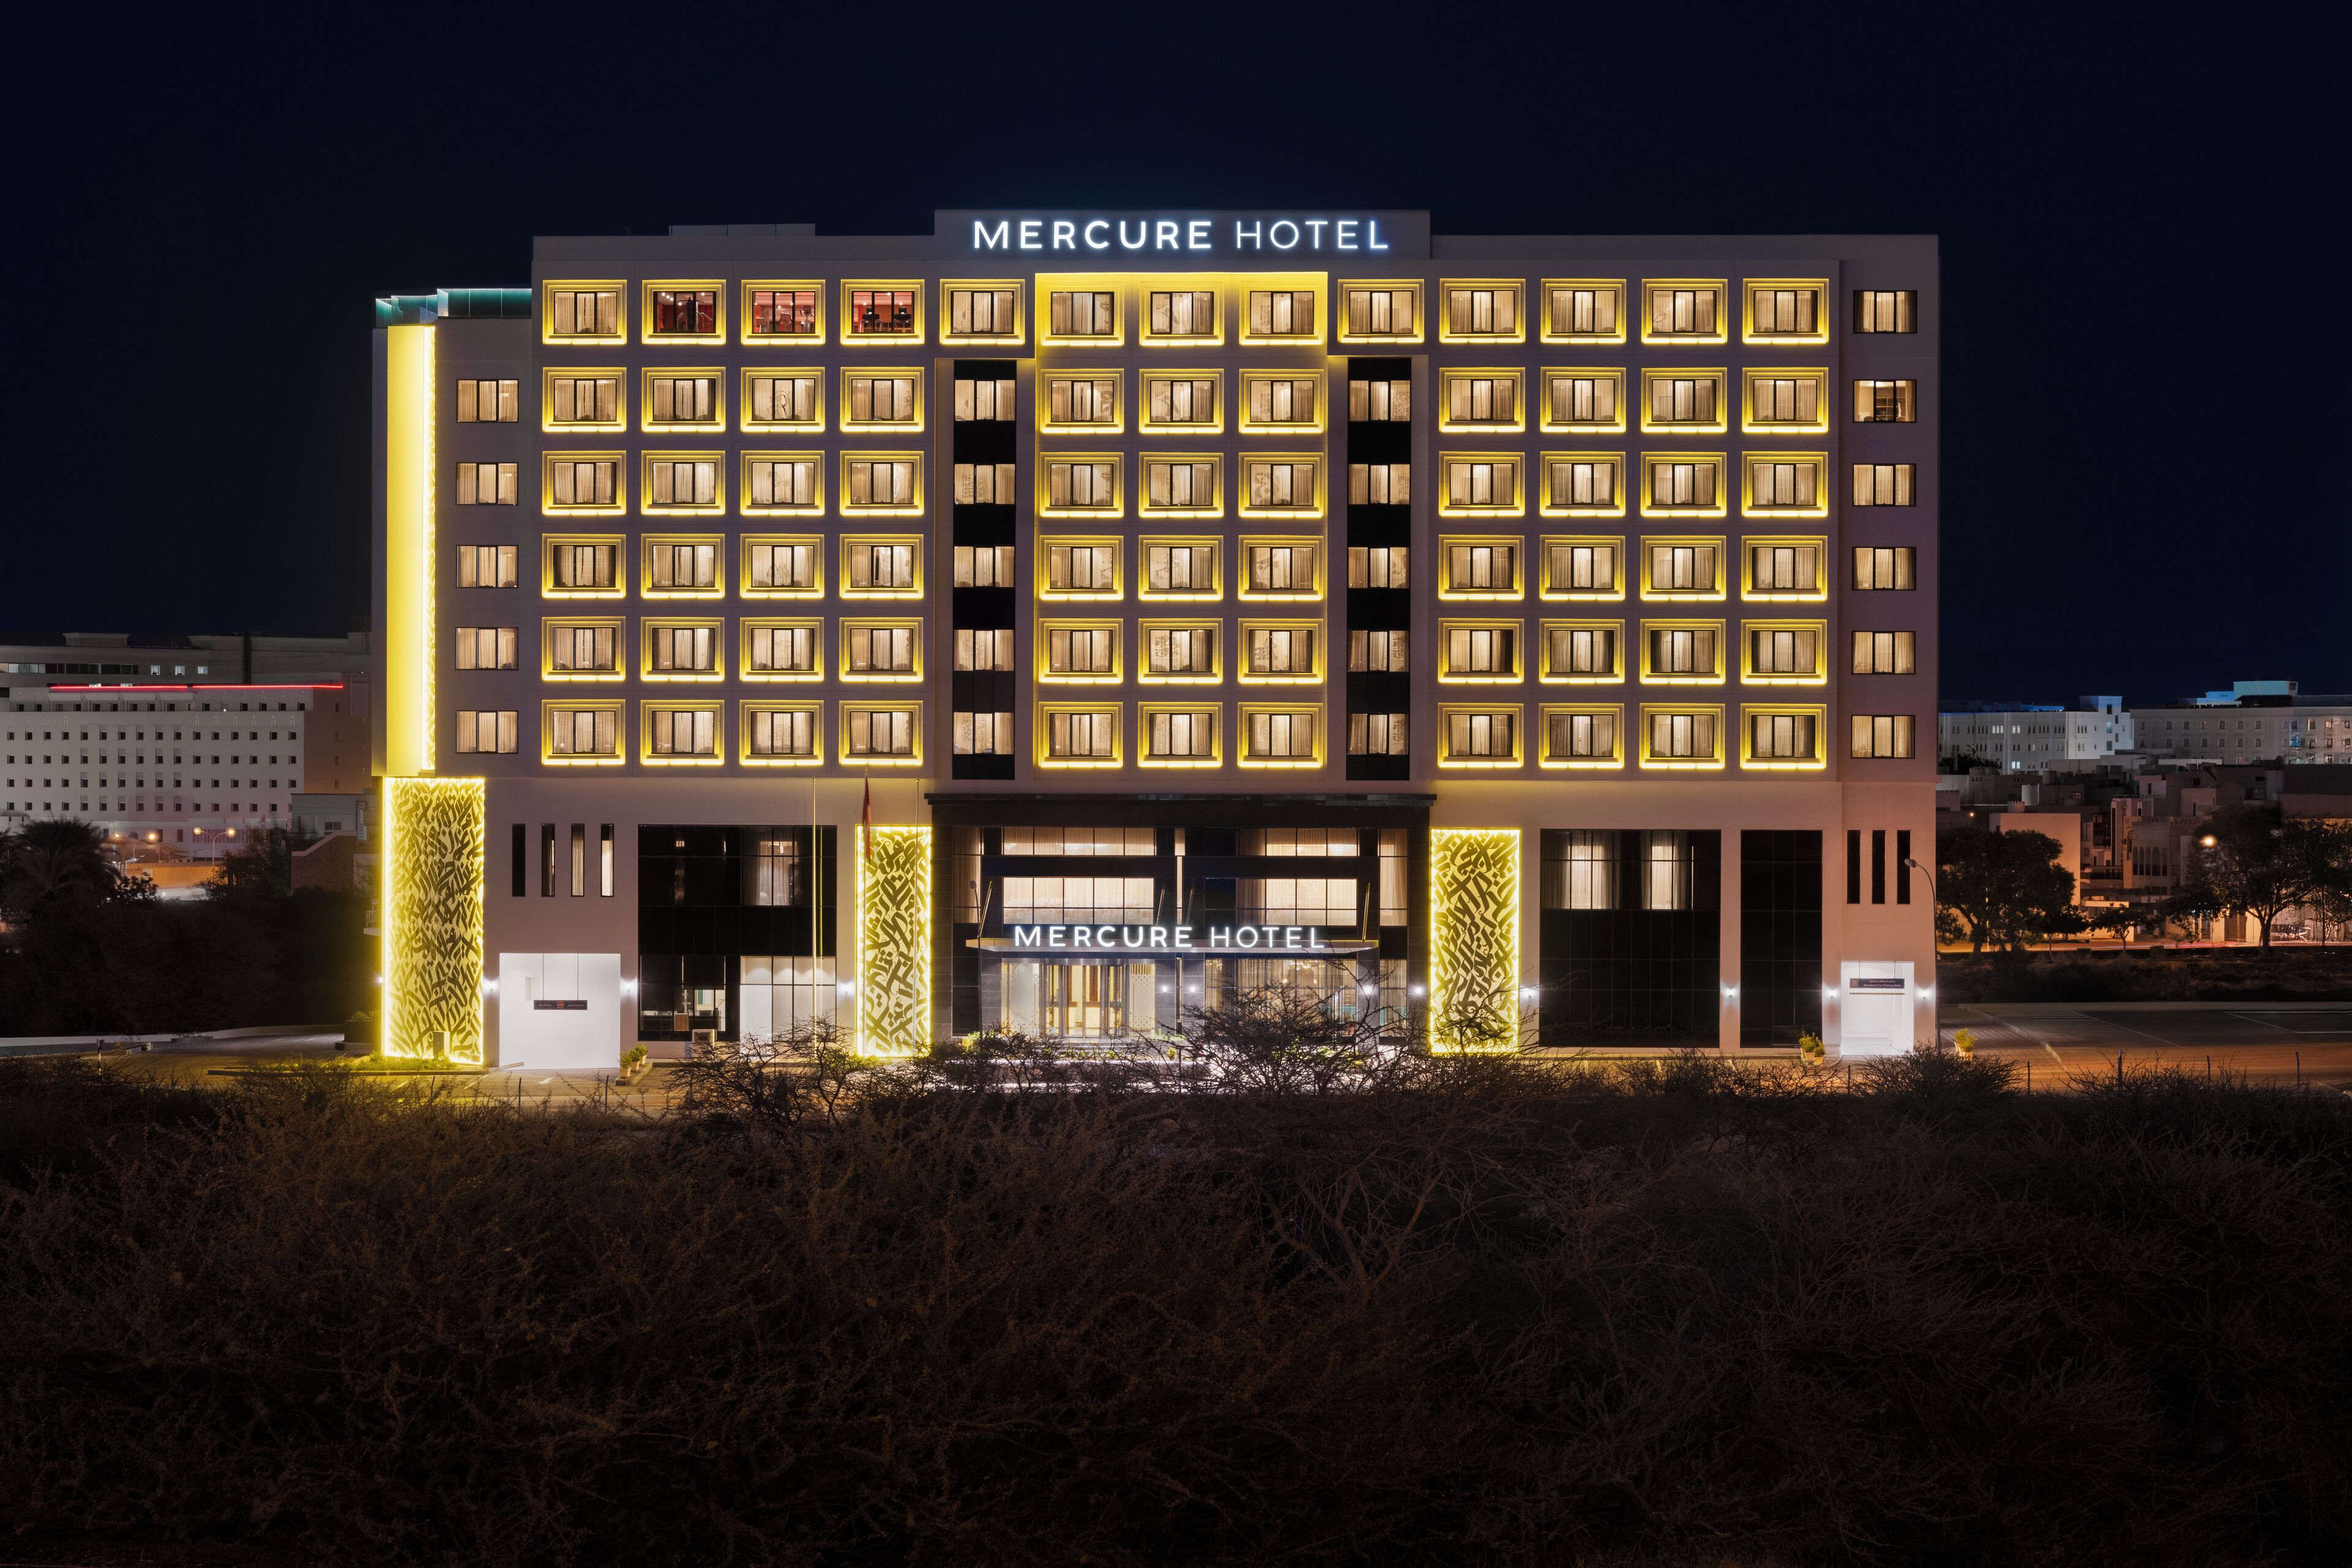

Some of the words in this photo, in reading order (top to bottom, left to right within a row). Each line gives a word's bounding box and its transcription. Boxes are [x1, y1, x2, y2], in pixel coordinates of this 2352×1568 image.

[974, 221, 1212, 249] MERCURE
[1237, 221, 1389, 249] HOTEL
[1015, 925, 1192, 948] MERCURE
[1211, 926, 1325, 948] HOTEL
